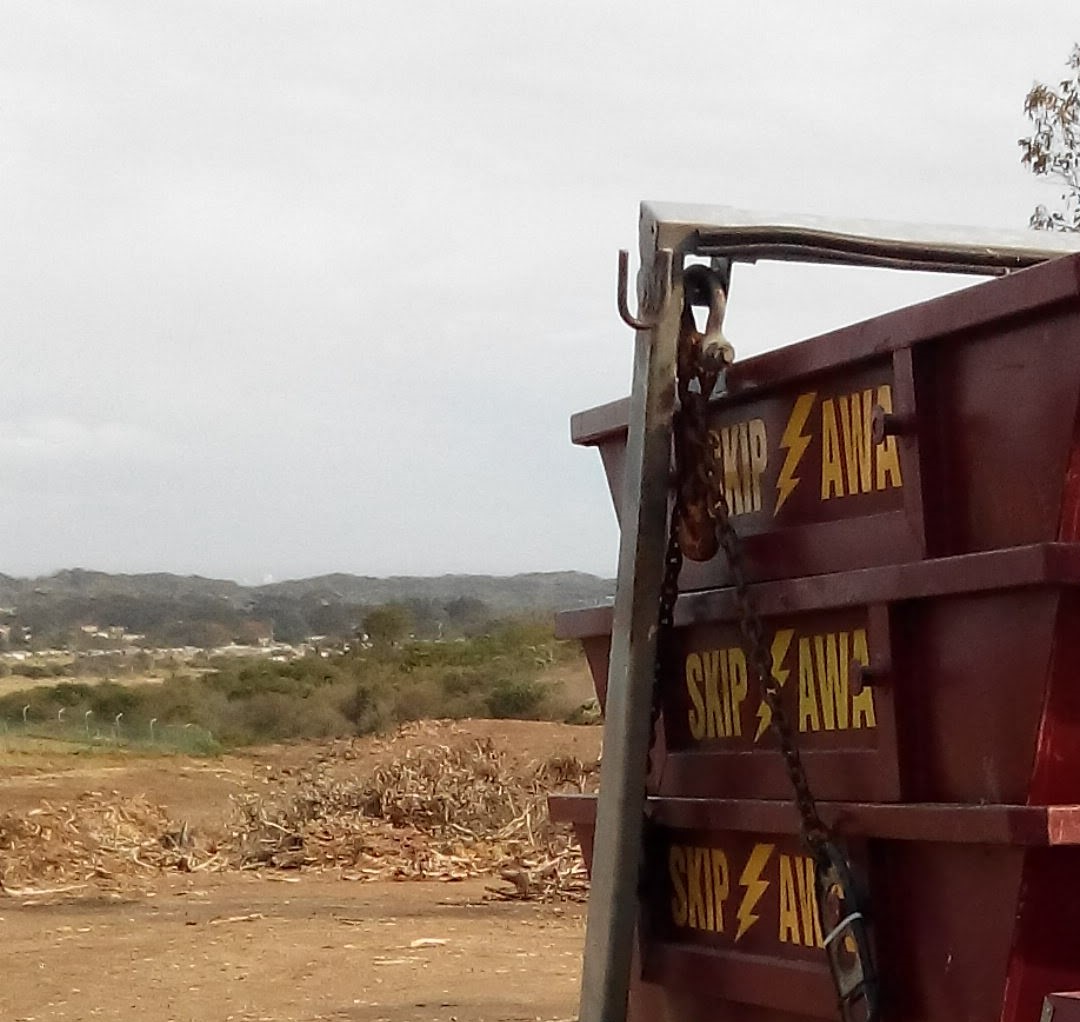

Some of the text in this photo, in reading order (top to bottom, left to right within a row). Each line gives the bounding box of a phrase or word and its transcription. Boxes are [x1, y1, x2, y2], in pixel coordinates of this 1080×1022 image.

[685, 647, 748, 740] SKIP
[669, 846, 858, 952] SKIP AW
